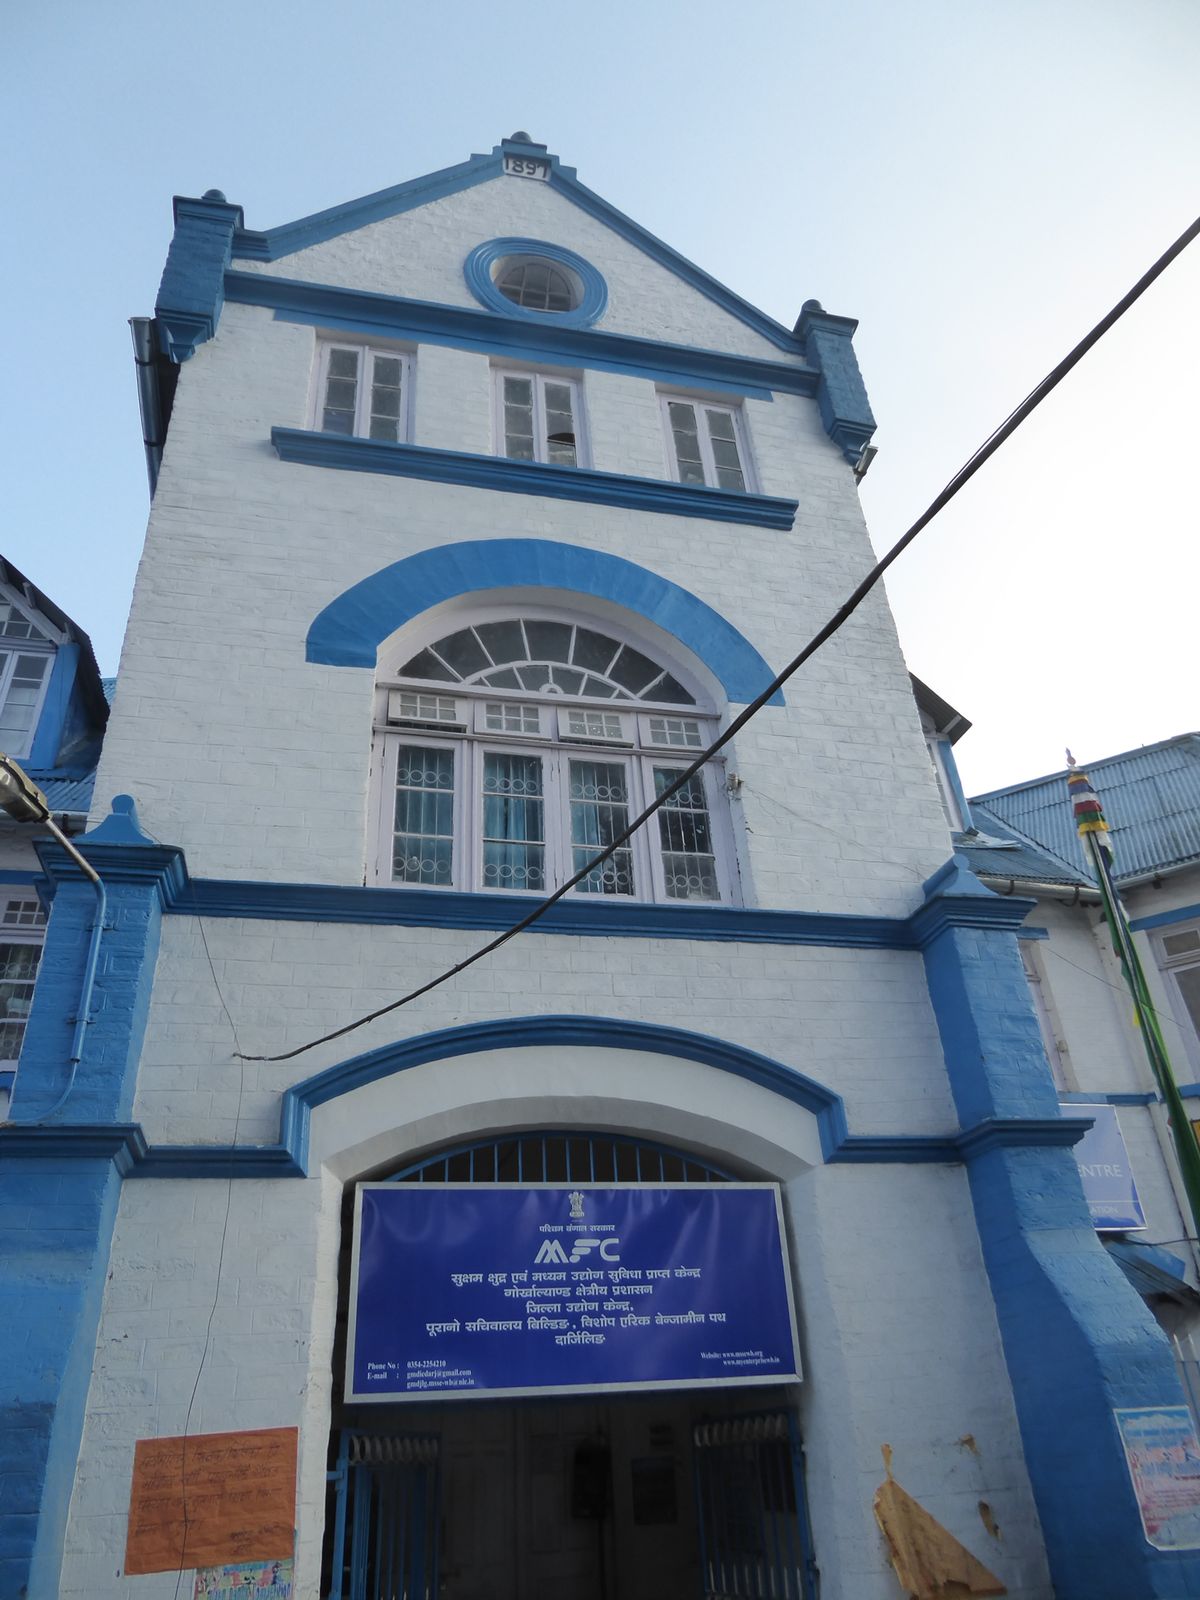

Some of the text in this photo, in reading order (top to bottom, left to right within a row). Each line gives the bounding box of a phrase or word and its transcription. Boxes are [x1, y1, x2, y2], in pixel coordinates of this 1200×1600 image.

[505, 157, 548, 179] 1897
[590, 1224, 615, 1232] सरकार
[511, 1270, 528, 1283] एवं
[532, 1271, 566, 1282] मध्यम
[571, 1268, 604, 1281] उद्योग
[608, 1267, 642, 1283] सुविधा
[646, 1268, 670, 1279] प्राप्त
[675, 1266, 701, 1278] केन्द्र
[576, 1282, 607, 1296] क्षेत्रीय
[612, 1284, 653, 1296] प्रशासन
[526, 1300, 561, 1314] जिल्ला
[566, 1299, 599, 1312] उद्योग
[426, 1319, 460, 1336] पूरानो
[465, 1318, 522, 1332] सचिवालय
[620, 1313, 650, 1328] एरिक
[709, 1312, 727, 1323] पथ
[367, 1362, 386, 1370] Phone
[367, 1372, 387, 1380] E-mail
